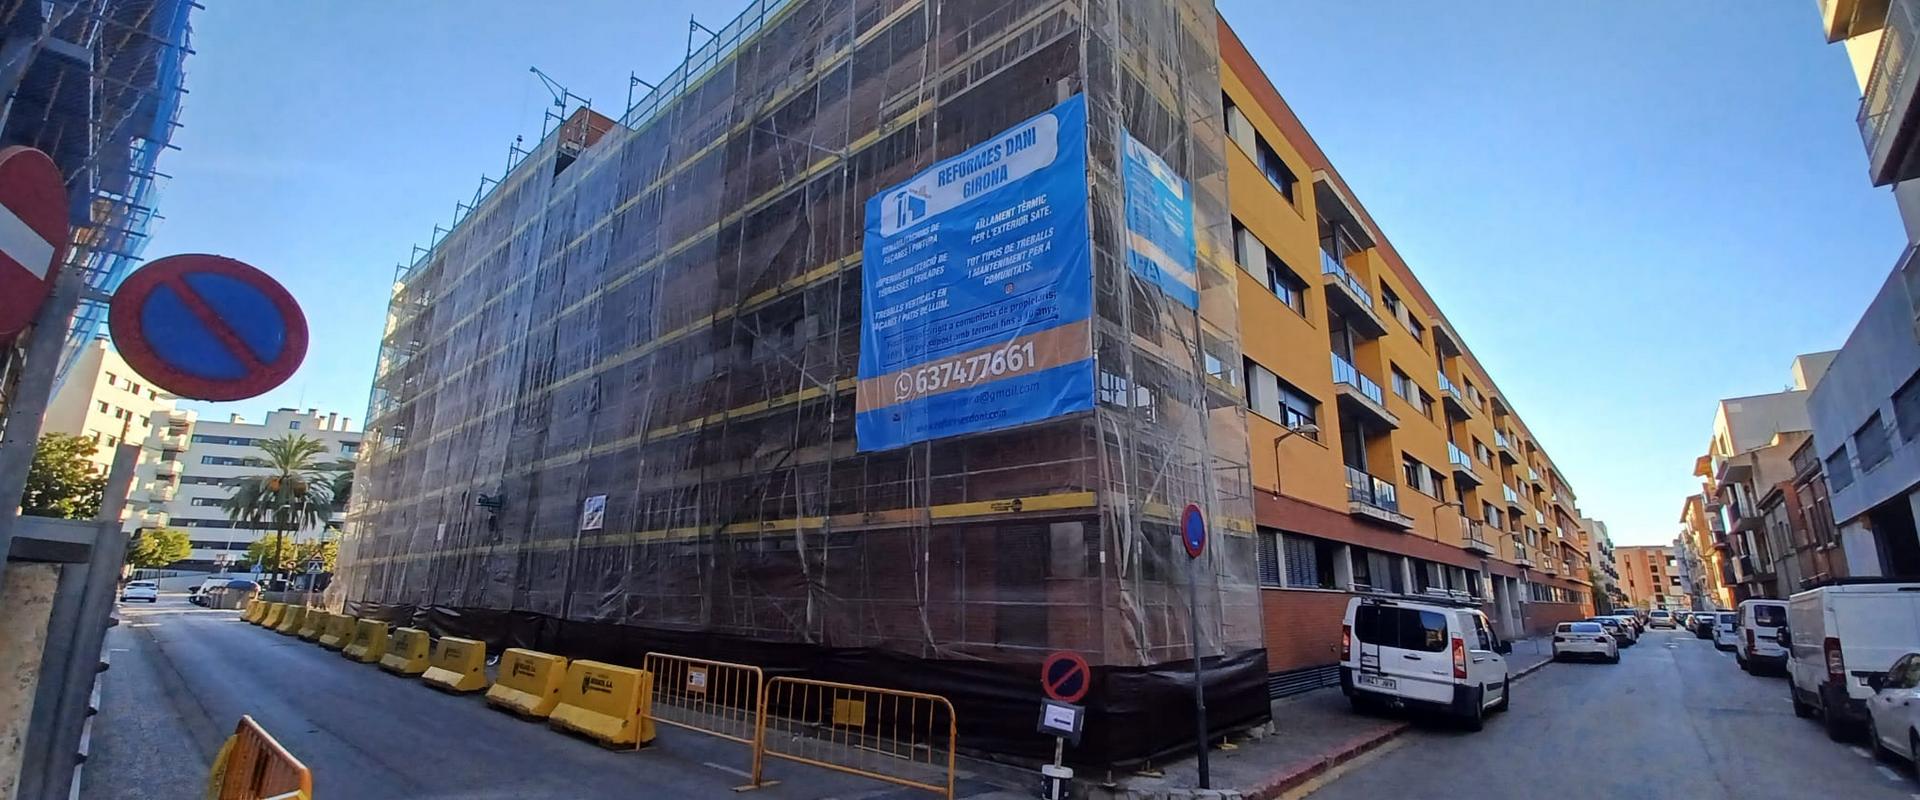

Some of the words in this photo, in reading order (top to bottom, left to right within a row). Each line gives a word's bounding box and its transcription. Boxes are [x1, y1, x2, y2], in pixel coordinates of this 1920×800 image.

[938, 144, 1001, 187] REFORMES
[1006, 127, 1036, 157] DANI
[963, 164, 1008, 198] GIRONA
[967, 256, 980, 267] TOT
[982, 247, 1003, 262] TIPUS
[1004, 242, 1015, 254] DE
[1017, 227, 1054, 250] TREBALLS
[971, 231, 985, 245] PER
[1028, 243, 1044, 258] PER
[1045, 240, 1051, 252] A
[937, 287, 948, 298] EN
[915, 341, 1035, 393] 637477661
